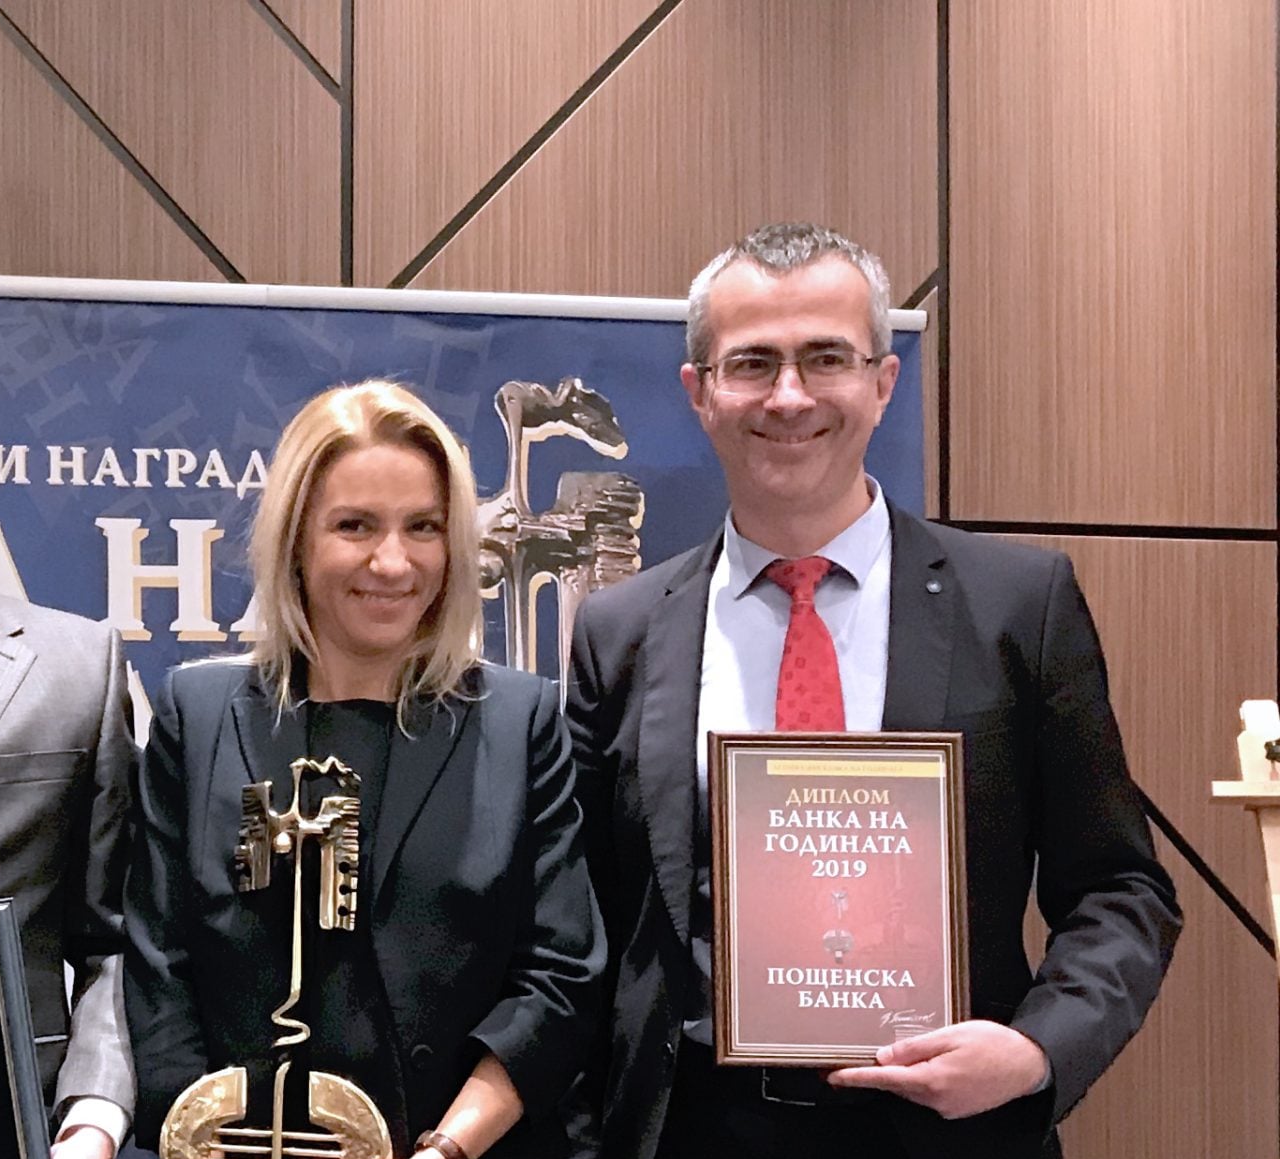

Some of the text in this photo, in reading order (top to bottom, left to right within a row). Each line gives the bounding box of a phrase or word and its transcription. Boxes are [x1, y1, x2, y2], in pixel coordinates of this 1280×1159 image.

[785, 787, 890, 807] ДИПЛОМ
[768, 808, 909, 830] БАНКА НА
[764, 833, 913, 856] ГОДИНАТА
[811, 859, 868, 878] 2019
[766, 967, 916, 989] ПОЩЕНСКА
[798, 989, 886, 1010] БАНКА
